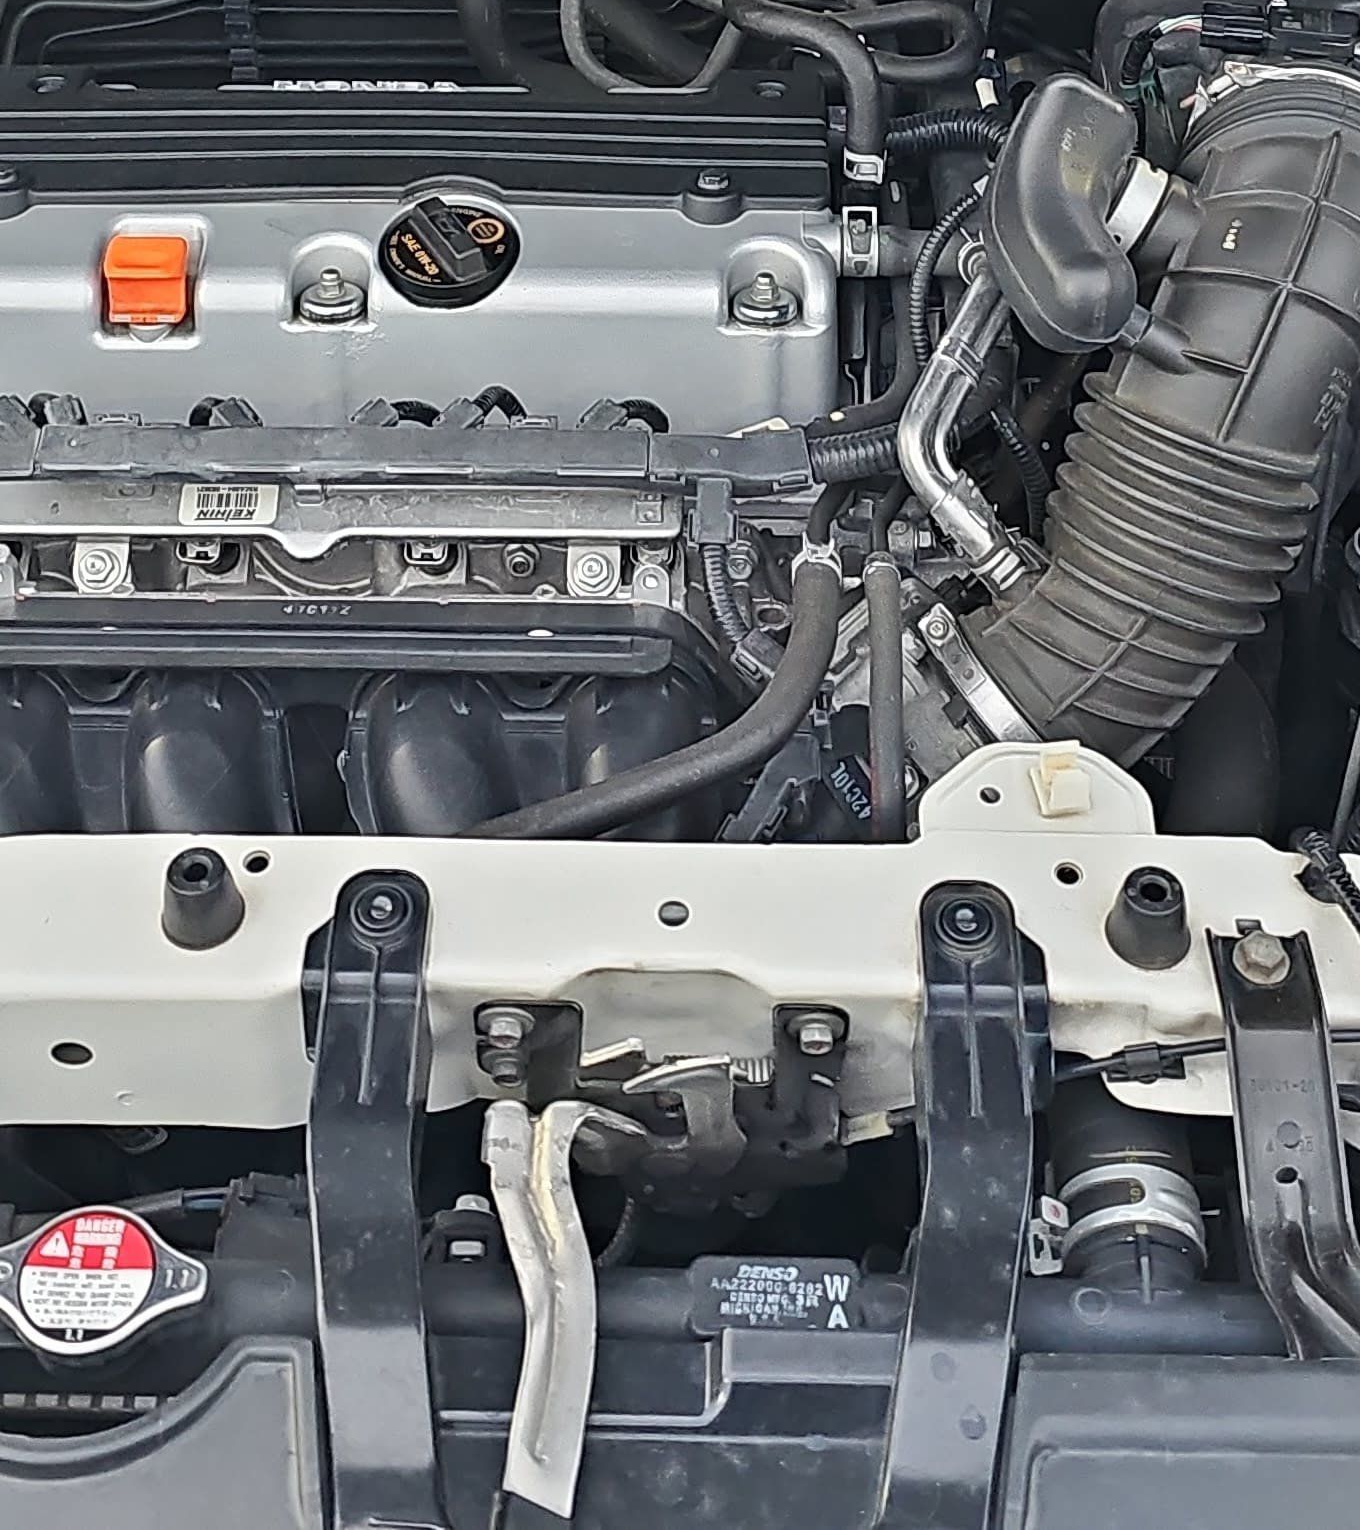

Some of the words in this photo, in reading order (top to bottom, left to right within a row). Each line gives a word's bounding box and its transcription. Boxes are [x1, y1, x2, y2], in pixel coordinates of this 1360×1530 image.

[401, 232, 421, 253] SAE
[414, 250, 440, 276] 0W-20
[196, 508, 257, 522] KEIHIN
[830, 761, 872, 820] 42C10L
[75, 1218, 126, 1233] DANGER
[736, 1264, 799, 1281] DENSO
[823, 1273, 850, 1302] W
[827, 1303, 850, 1329] A
